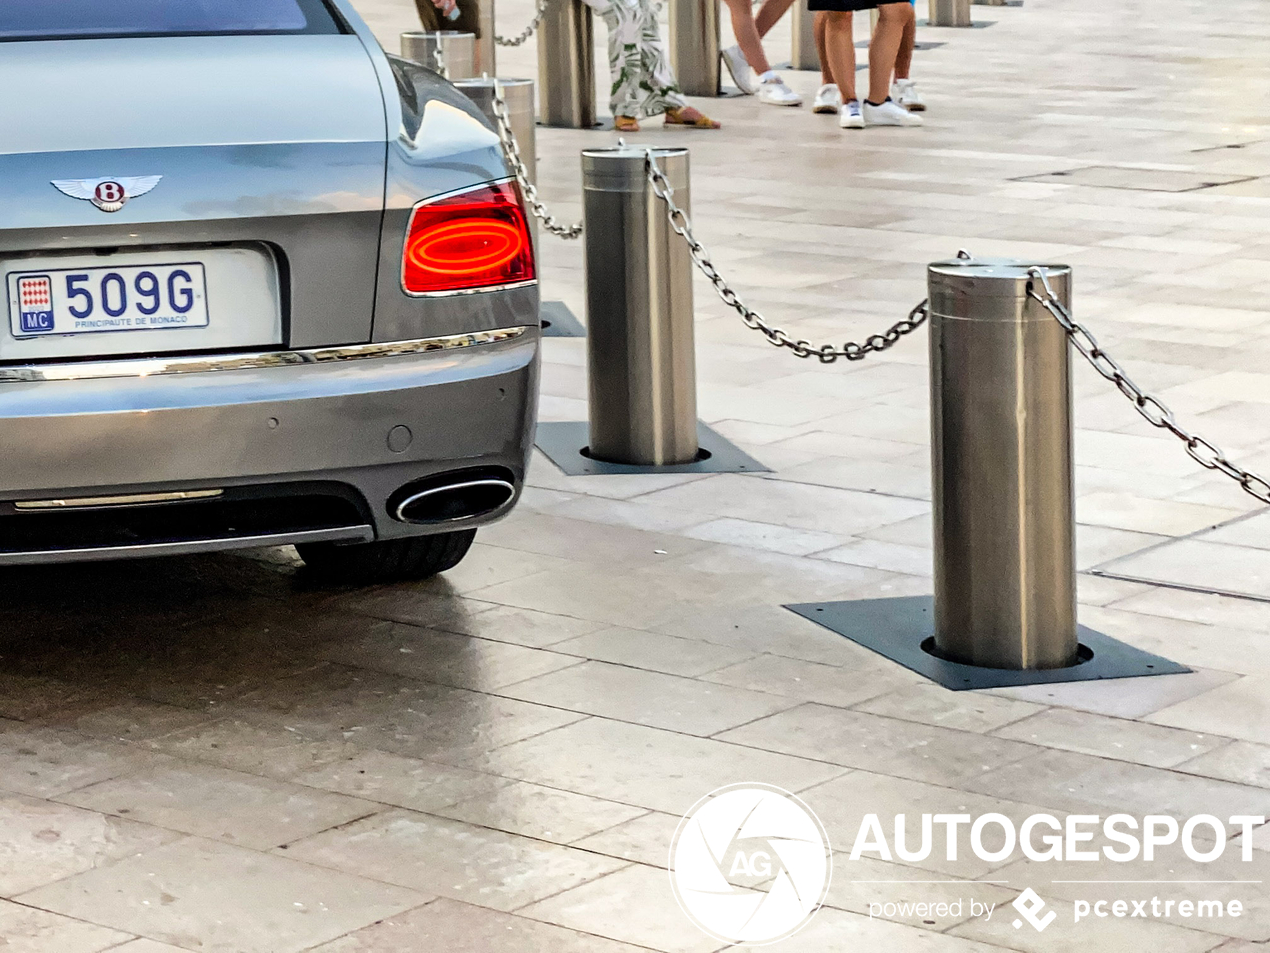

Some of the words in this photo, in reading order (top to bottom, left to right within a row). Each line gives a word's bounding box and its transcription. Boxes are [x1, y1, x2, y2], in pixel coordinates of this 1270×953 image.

[99, 182, 121, 201] B
[66, 269, 195, 319] 509G
[27, 313, 48, 328] MC
[75, 318, 132, 328] PRINCIPAUTE
[135, 317, 146, 325] DE
[150, 315, 188, 324] MONACO
